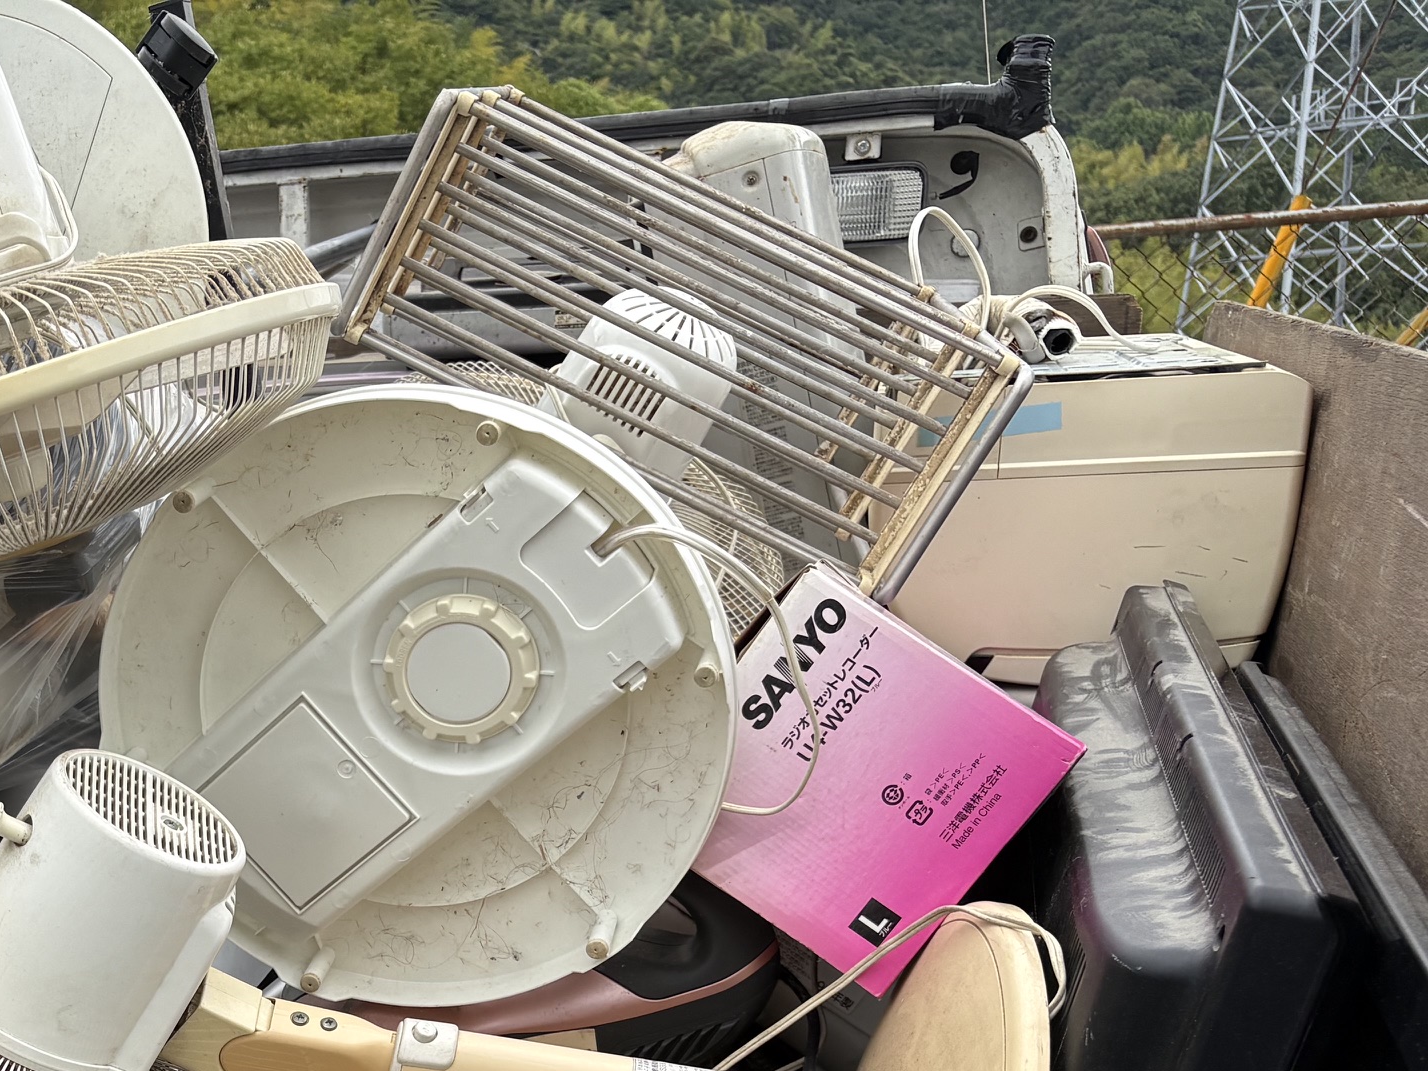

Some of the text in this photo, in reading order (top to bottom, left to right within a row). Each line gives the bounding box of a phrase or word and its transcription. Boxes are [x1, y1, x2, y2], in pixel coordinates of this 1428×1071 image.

[741, 598, 847, 730] SANYO
[939, 764, 1009, 842] 三洋電機株式会社
[952, 791, 1001, 849] Made in China
[860, 909, 889, 936] L
